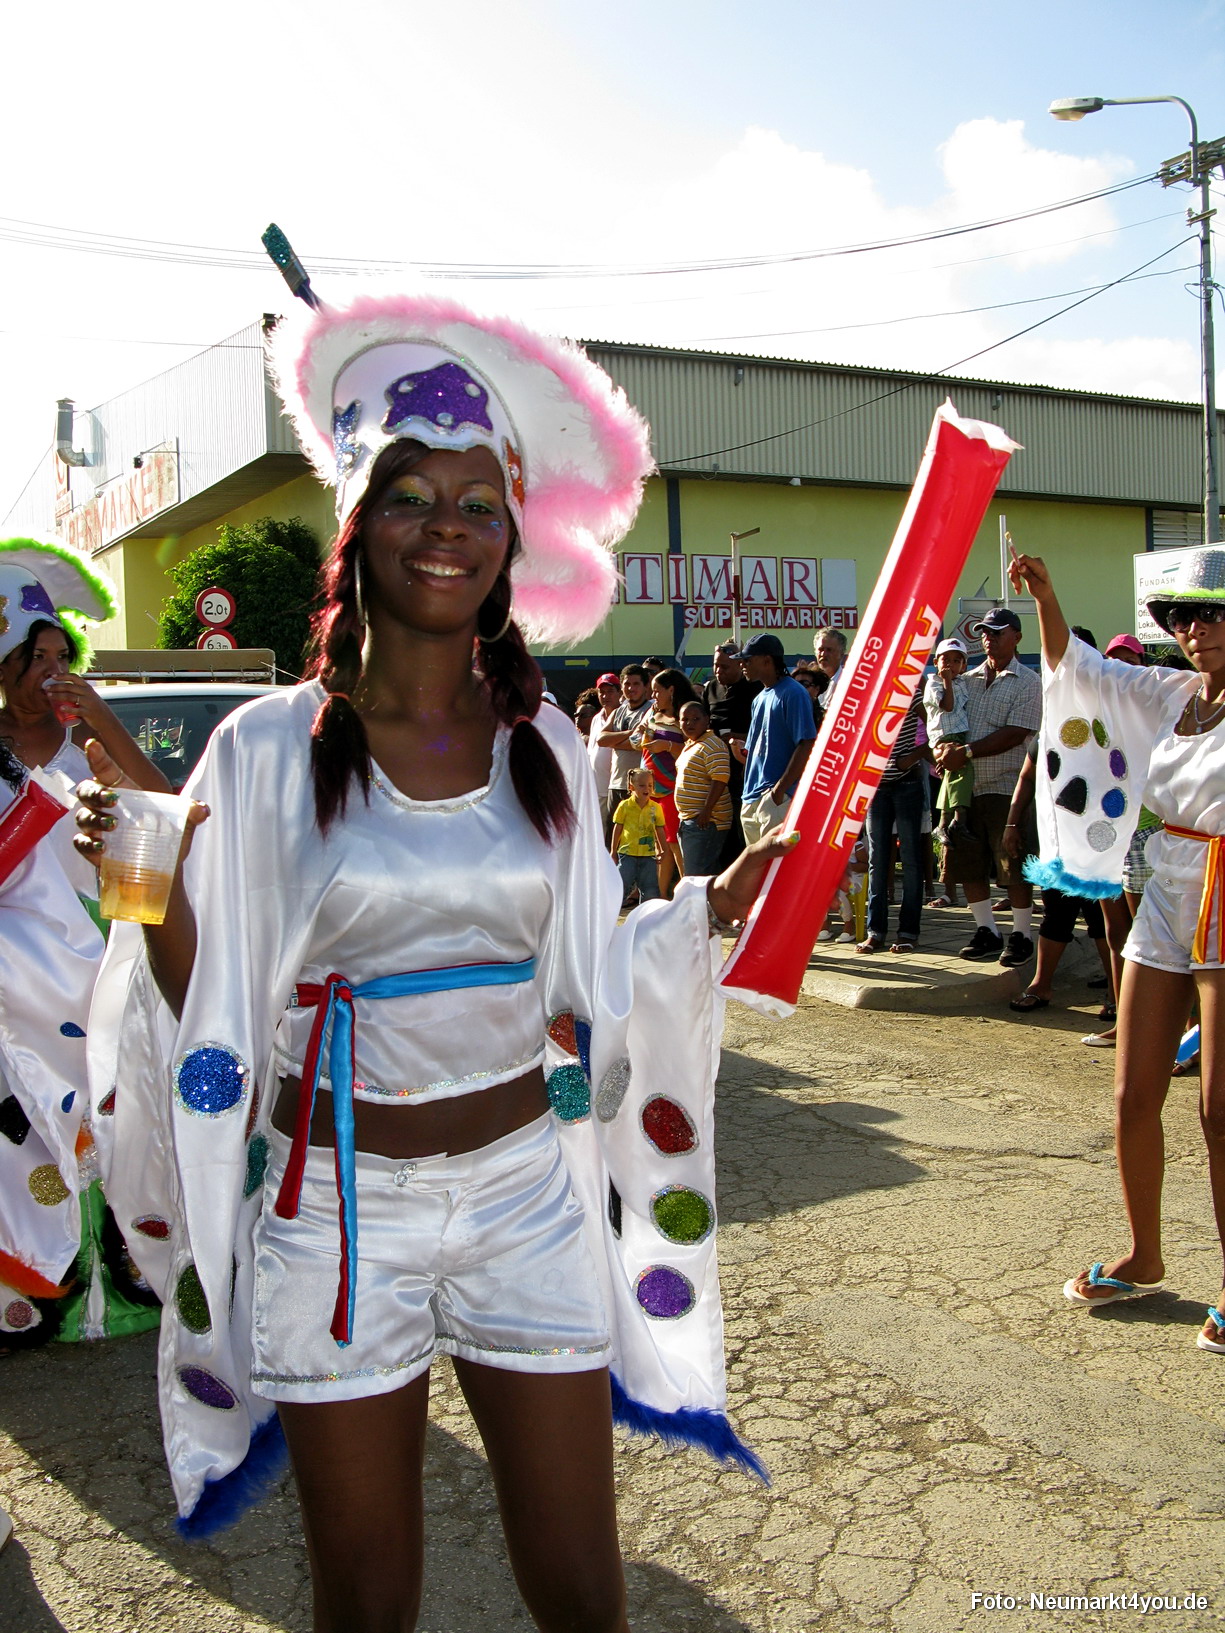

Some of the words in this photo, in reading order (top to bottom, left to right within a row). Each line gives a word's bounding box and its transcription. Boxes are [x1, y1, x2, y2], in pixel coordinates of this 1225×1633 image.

[58, 455, 165, 552] PERMARKET
[613, 556, 818, 602] TIMAR
[685, 607, 858, 627] SUPERMARKET
[831, 696, 861, 745] más
[812, 748, 845, 797] friu!
